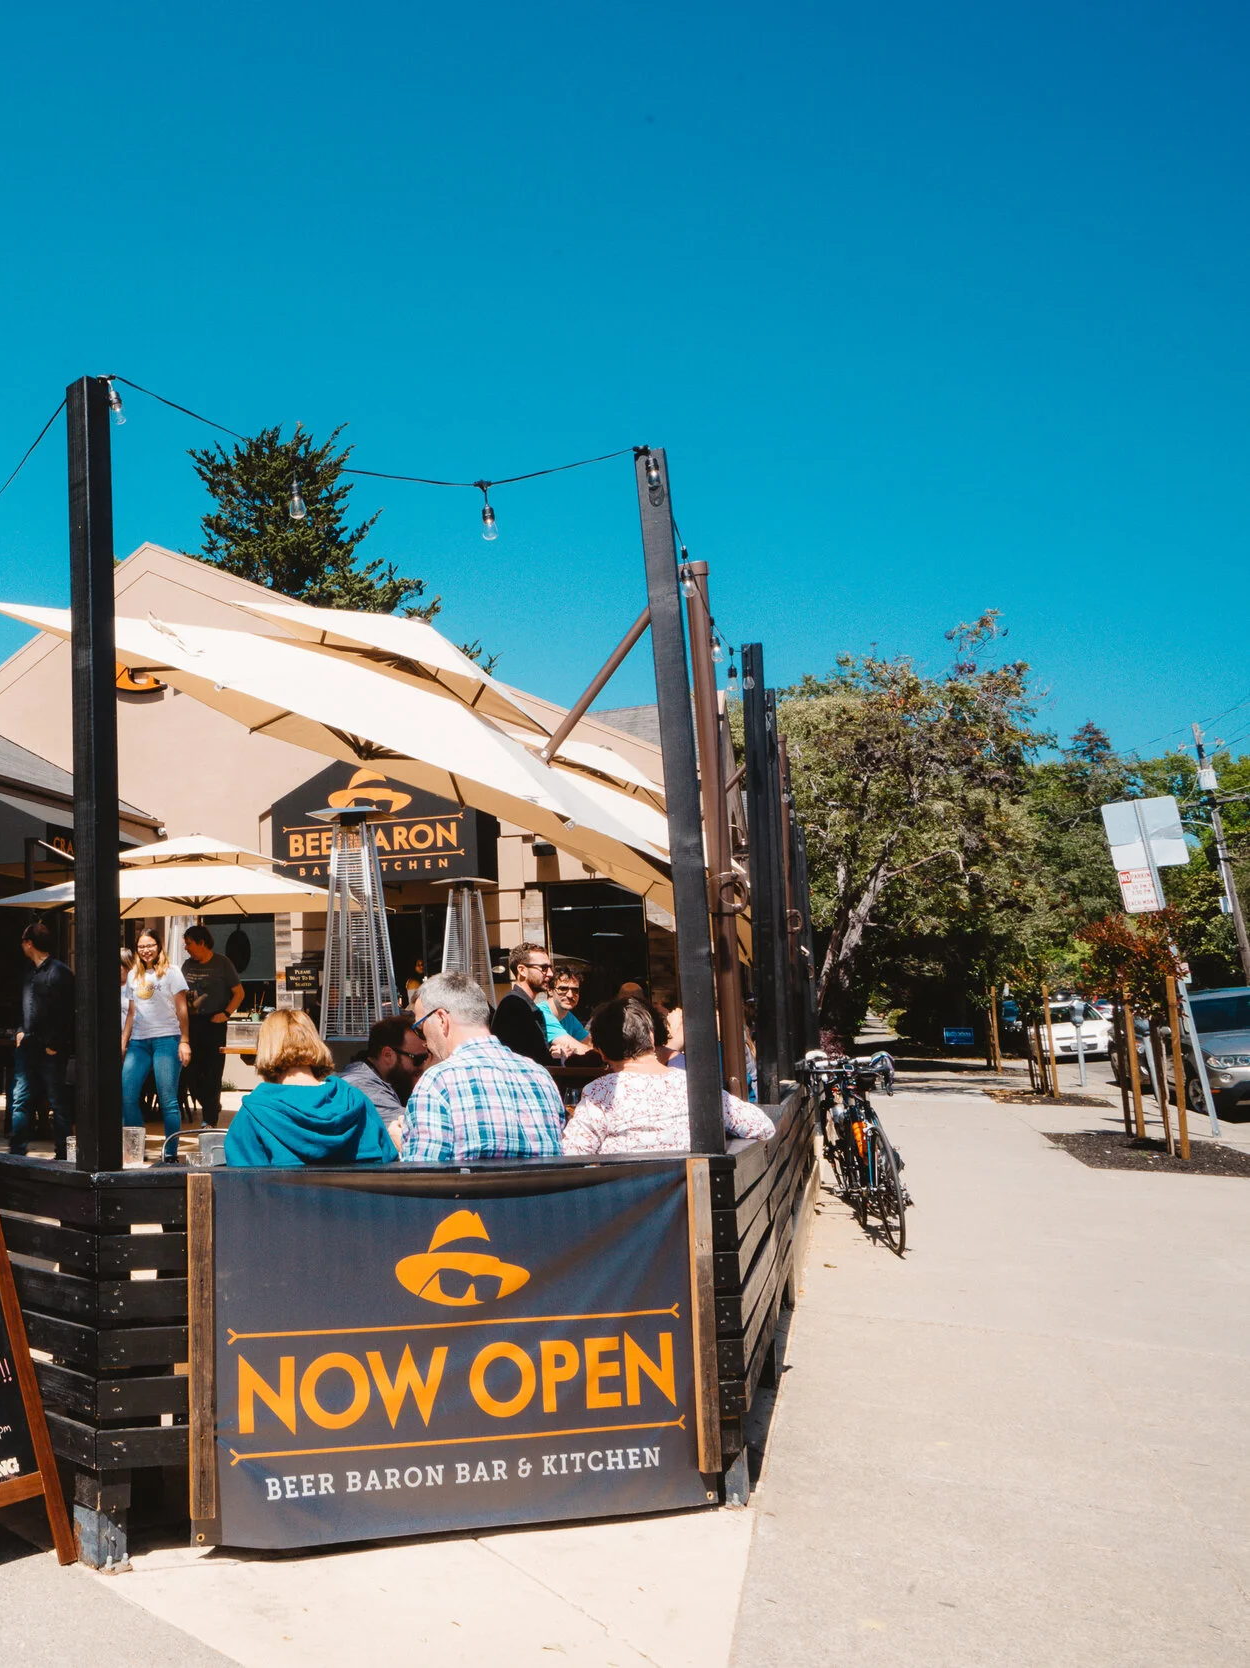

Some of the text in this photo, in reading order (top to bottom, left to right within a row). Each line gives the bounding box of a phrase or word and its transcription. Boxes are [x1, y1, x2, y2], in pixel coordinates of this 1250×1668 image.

[356, 822, 458, 854] ARON
[381, 858, 449, 872] TCHEN
[1120, 872, 1152, 882] NO PARKIN
[238, 1331, 678, 1436] NOW OPEN
[266, 1447, 661, 1501] BEER BARON BAR & KITCHEN
